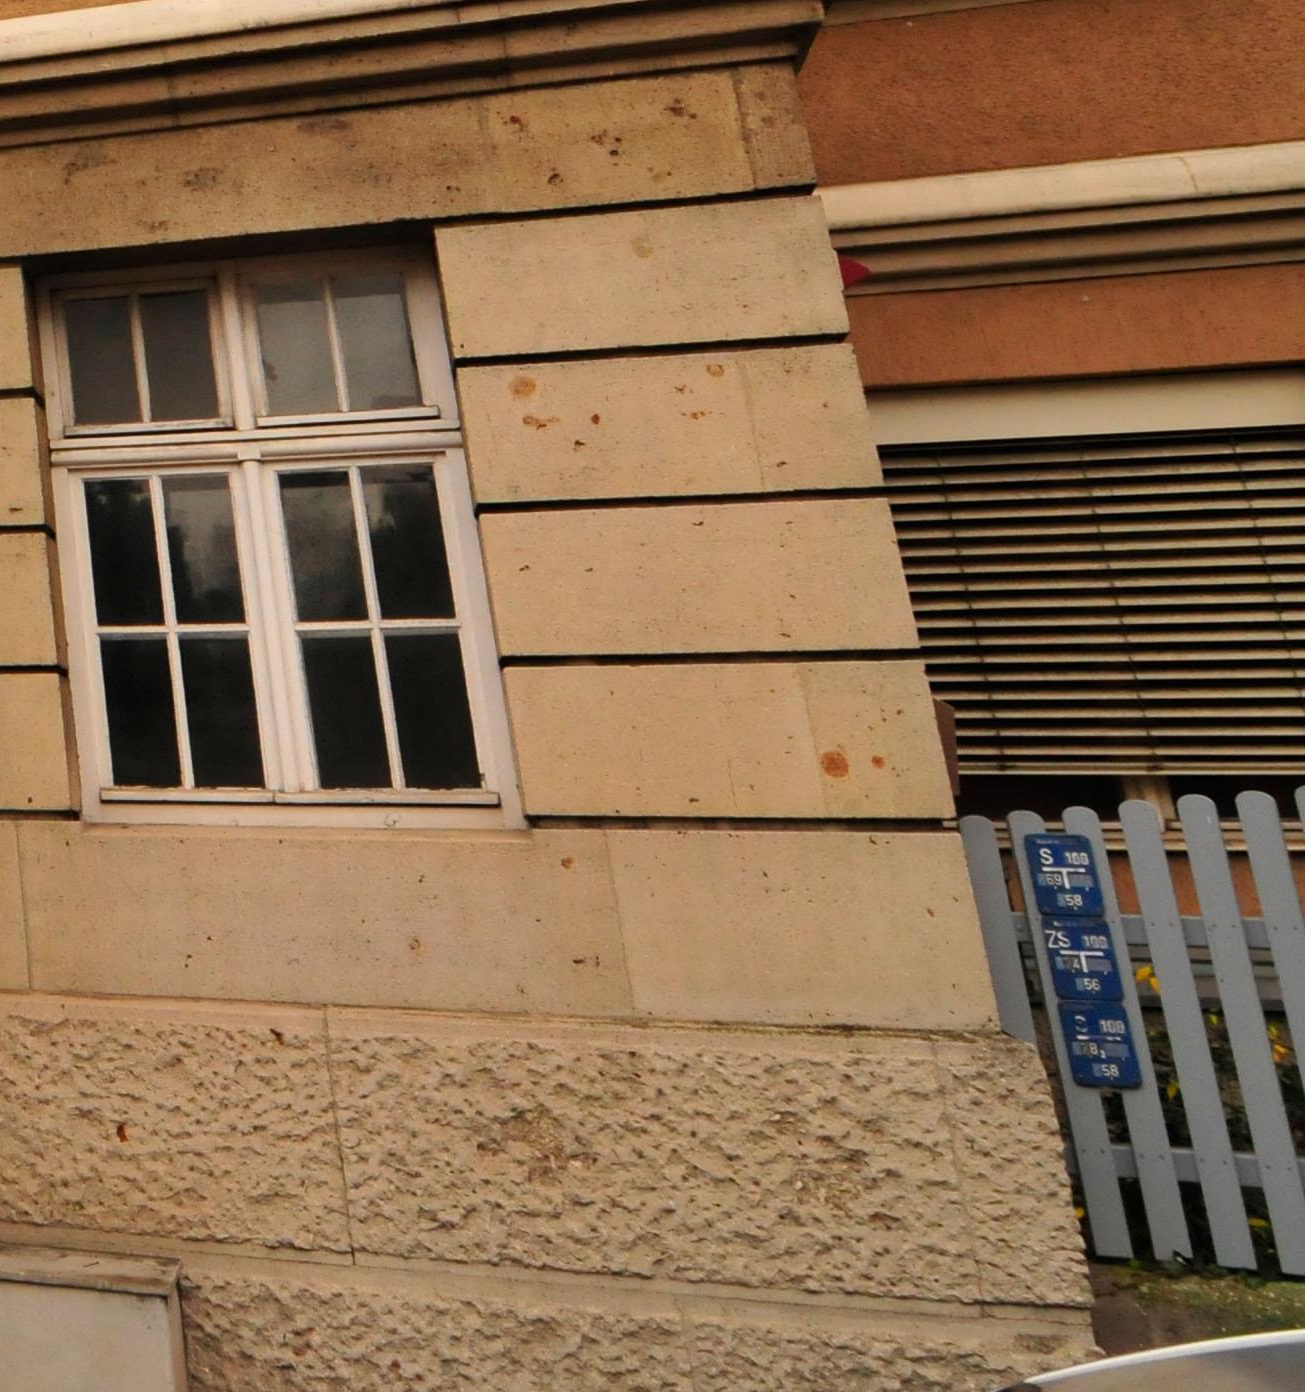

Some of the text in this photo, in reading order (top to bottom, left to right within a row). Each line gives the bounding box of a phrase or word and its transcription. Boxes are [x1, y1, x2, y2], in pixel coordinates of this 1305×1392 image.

[1039, 848, 1089, 865] S 100
[1044, 930, 1071, 948] ZS
[1100, 1020, 1126, 1034] 100
